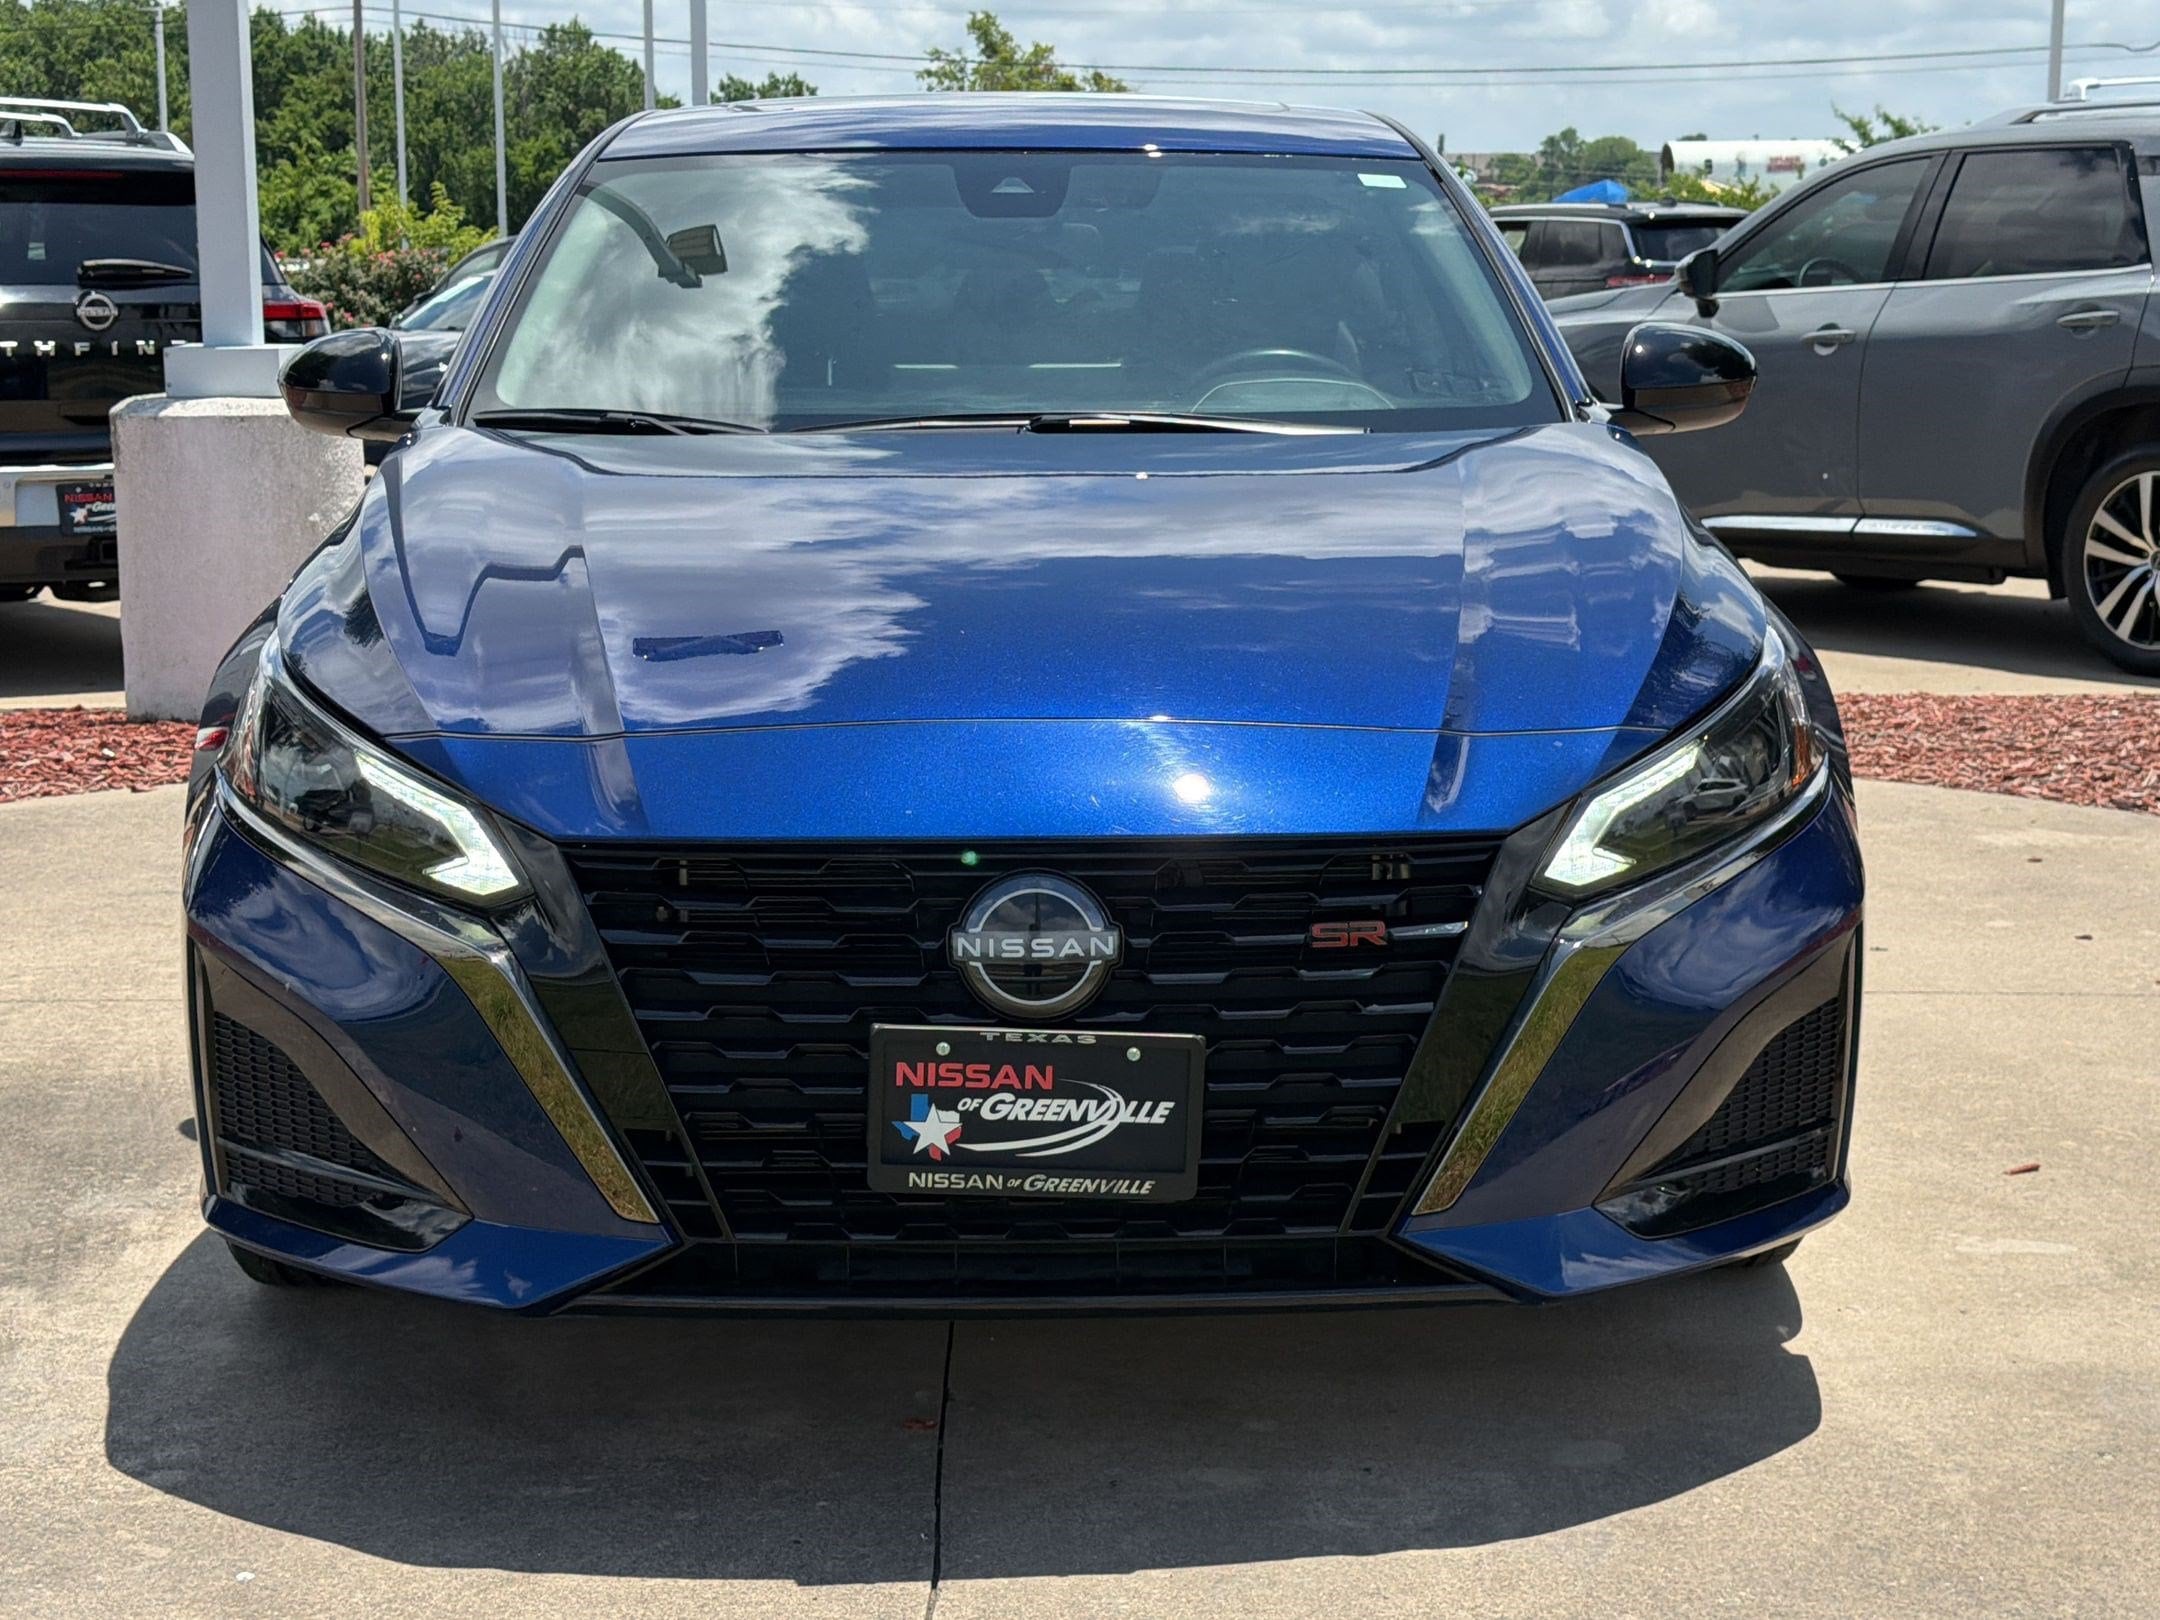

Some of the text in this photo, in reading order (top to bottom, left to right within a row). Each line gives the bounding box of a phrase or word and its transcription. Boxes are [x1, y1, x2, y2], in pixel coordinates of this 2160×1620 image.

[956, 934, 1115, 958] NISSAN
[1310, 920, 1388, 948] SR
[980, 1032, 1097, 1044] TEXAS
[895, 1062, 1054, 1090] NISSAN
[957, 1092, 1176, 1124] OF GREENVILLE
[908, 1172, 1156, 1195] NISSAN OF GREENVILLE
